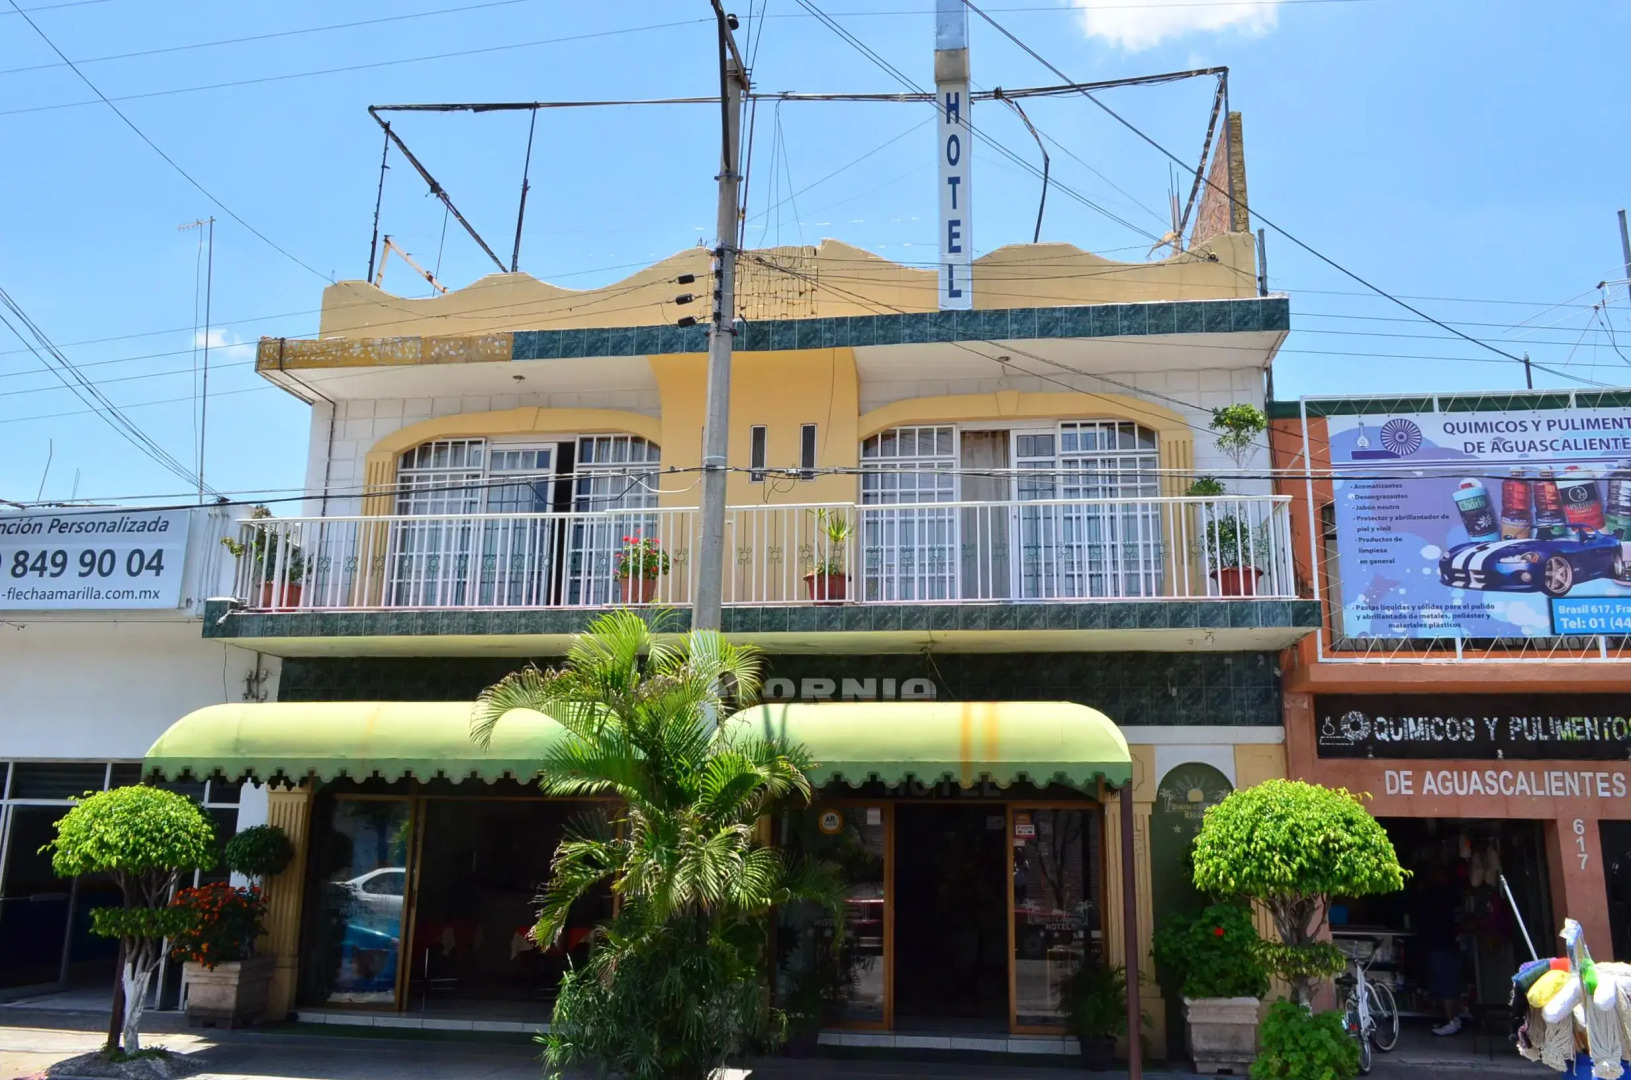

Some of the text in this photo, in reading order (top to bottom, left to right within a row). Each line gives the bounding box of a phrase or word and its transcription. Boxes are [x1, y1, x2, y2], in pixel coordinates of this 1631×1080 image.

[946, 91, 962, 298] HOTEL
[1443, 420, 1528, 436] QUIMICOS
[1531, 420, 1542, 432] Y
[1463, 437, 1631, 455] DE AGUASCALIENTE
[47, 515, 170, 535] Personalizada
[1358, 547, 1388, 555] limpieza
[10, 549, 68, 579] 849
[78, 548, 116, 578] 90
[126, 548, 164, 577] 04
[1369, 558, 1395, 566] general
[1, 585, 160, 601] -flechaamarilla.com.mx
[1417, 603, 1443, 611] sólidas
[1444, 604, 1461, 612] para
[1471, 603, 1495, 612] pulido
[1558, 604, 1589, 614] Brasil
[1590, 604, 1614, 615] 617,
[1362, 612, 1407, 620] abrillantado
[1408, 612, 1418, 620] de
[1452, 611, 1483, 621] poliéster
[1560, 617, 1587, 629] Tel:
[1588, 617, 1606, 629] 01
[1428, 621, 1462, 630] plásticos
[761, 677, 937, 702] ORNIA
[1372, 716, 1476, 742] QUIMICOS
[1483, 716, 1498, 741] Y
[1384, 770, 1627, 798] DE AGUASCALIENTES
